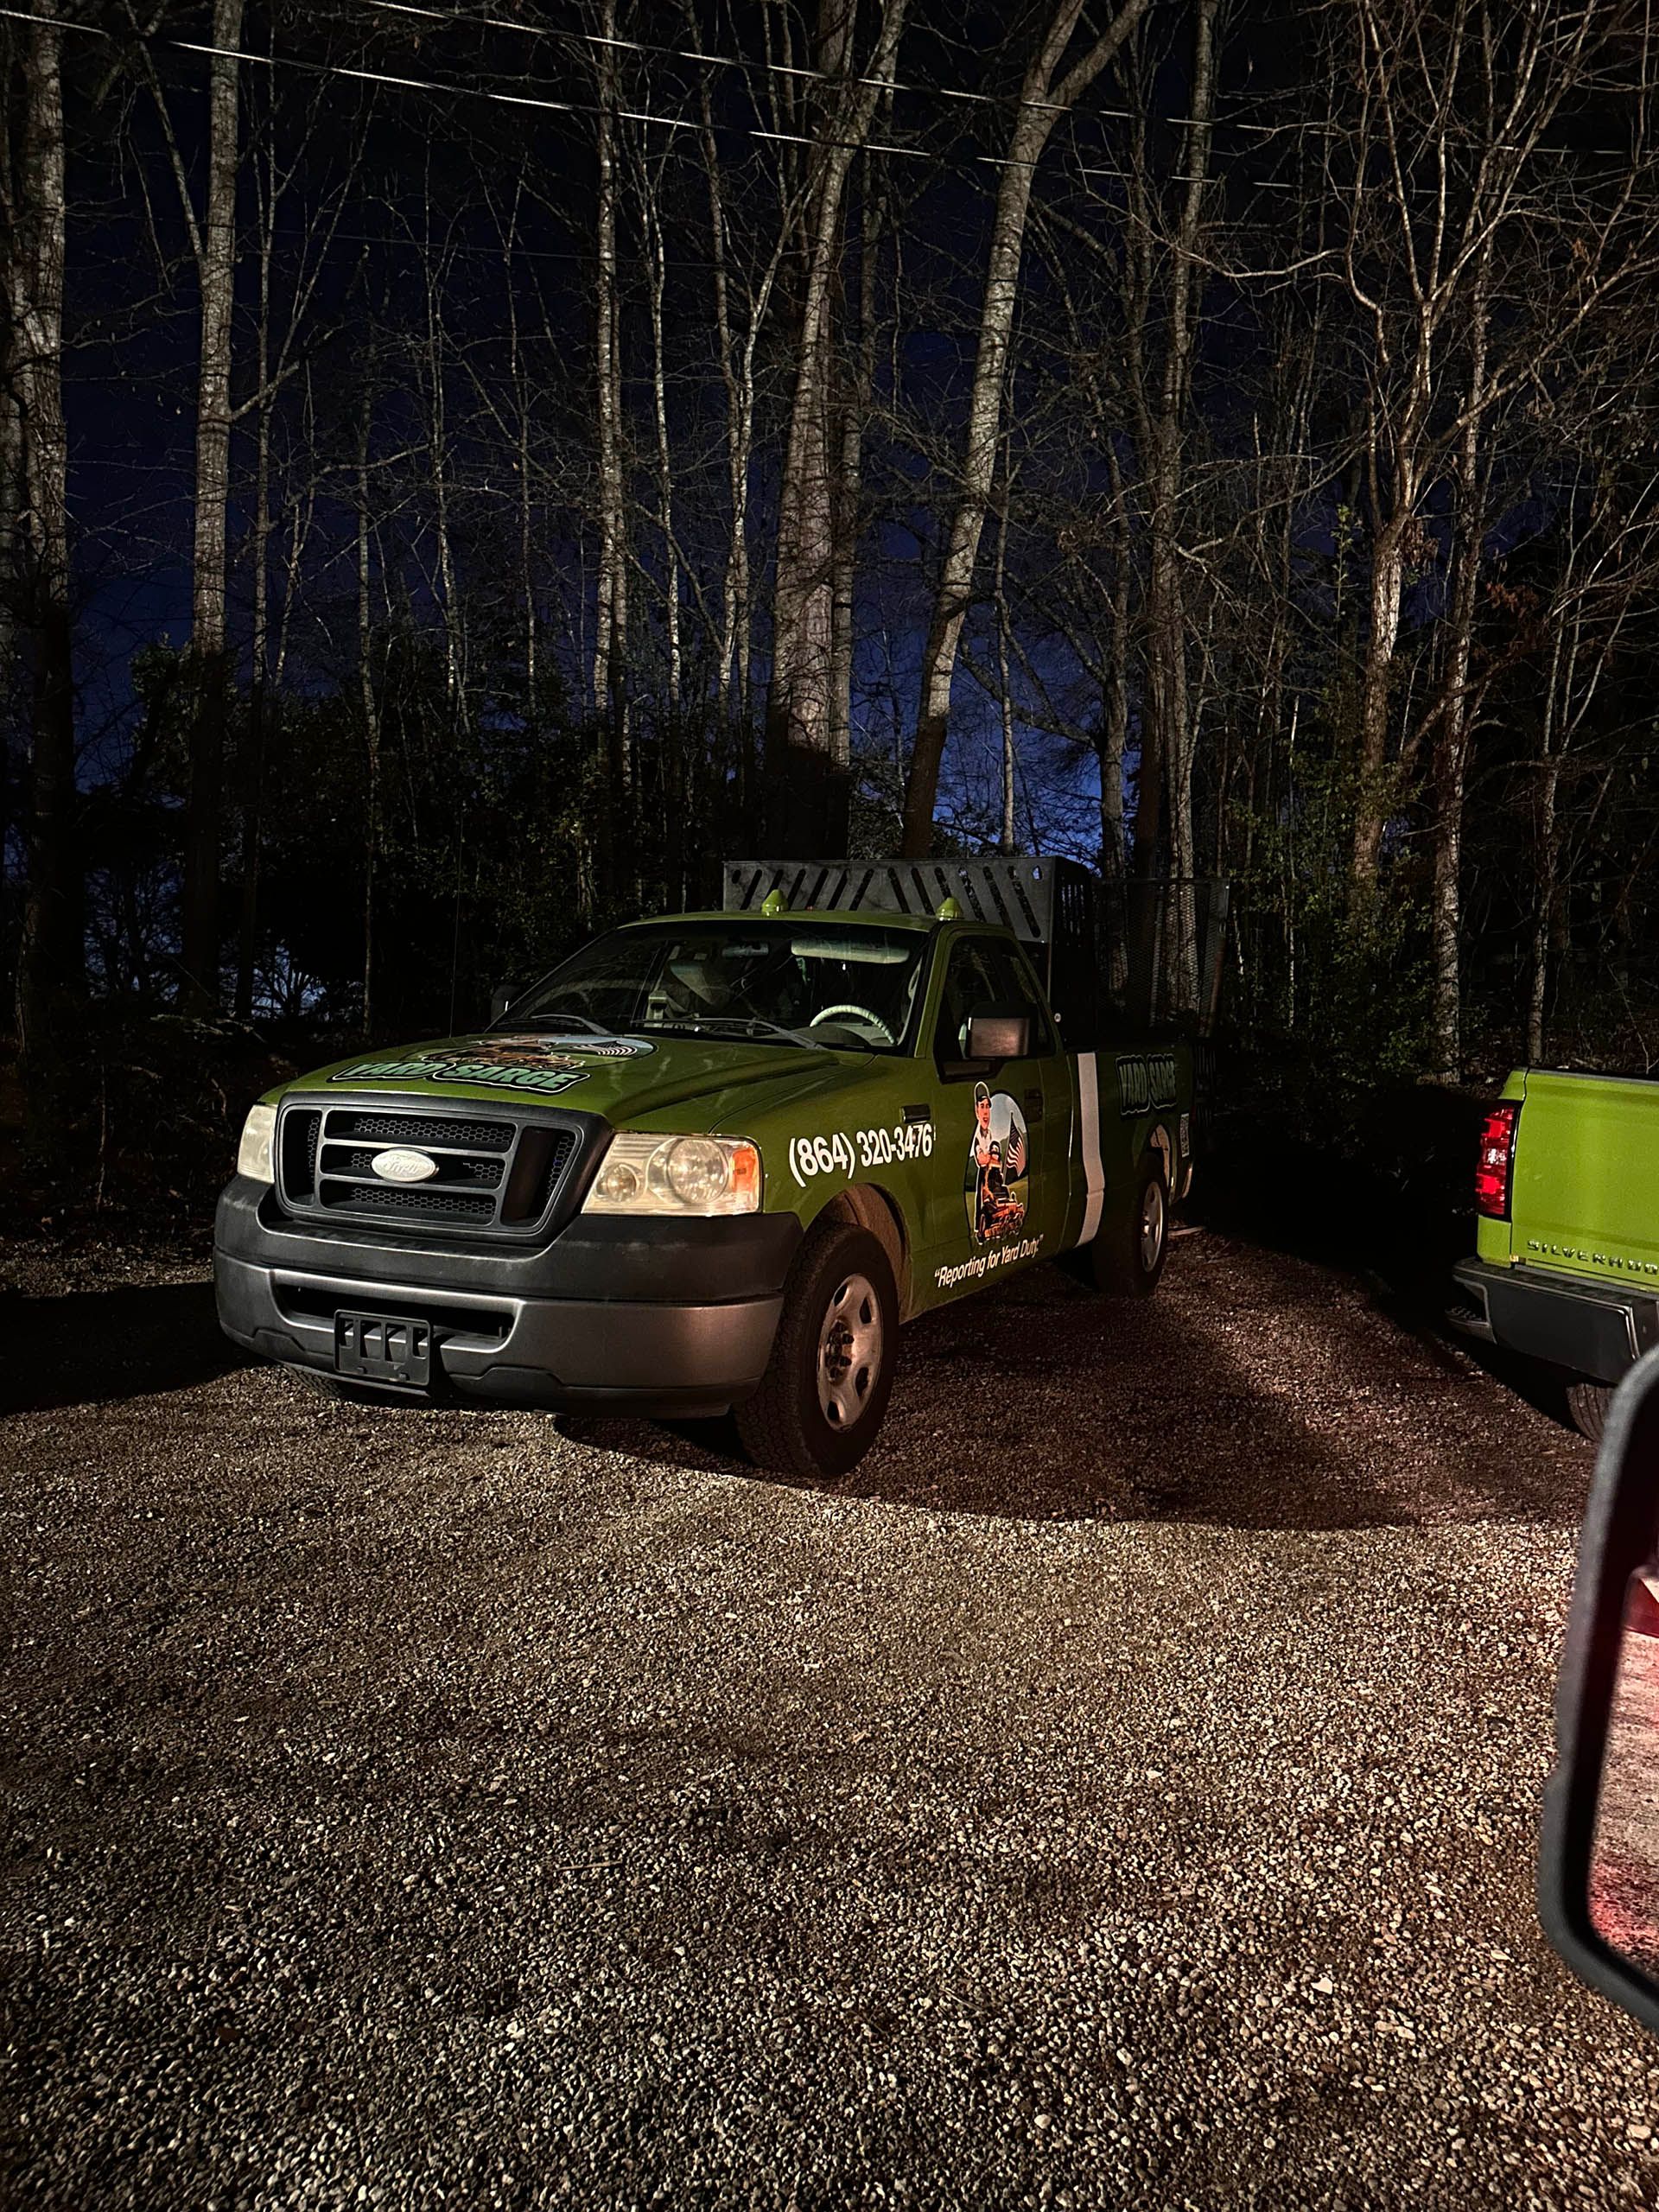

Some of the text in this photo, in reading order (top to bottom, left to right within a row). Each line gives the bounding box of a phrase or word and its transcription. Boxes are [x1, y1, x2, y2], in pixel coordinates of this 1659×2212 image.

[346, 1062, 579, 1090] YARD SARGE
[789, 1123, 932, 1187] (864) 320-3476
[987, 1249, 1001, 1270] for
[1001, 1241, 1020, 1264] Yard
